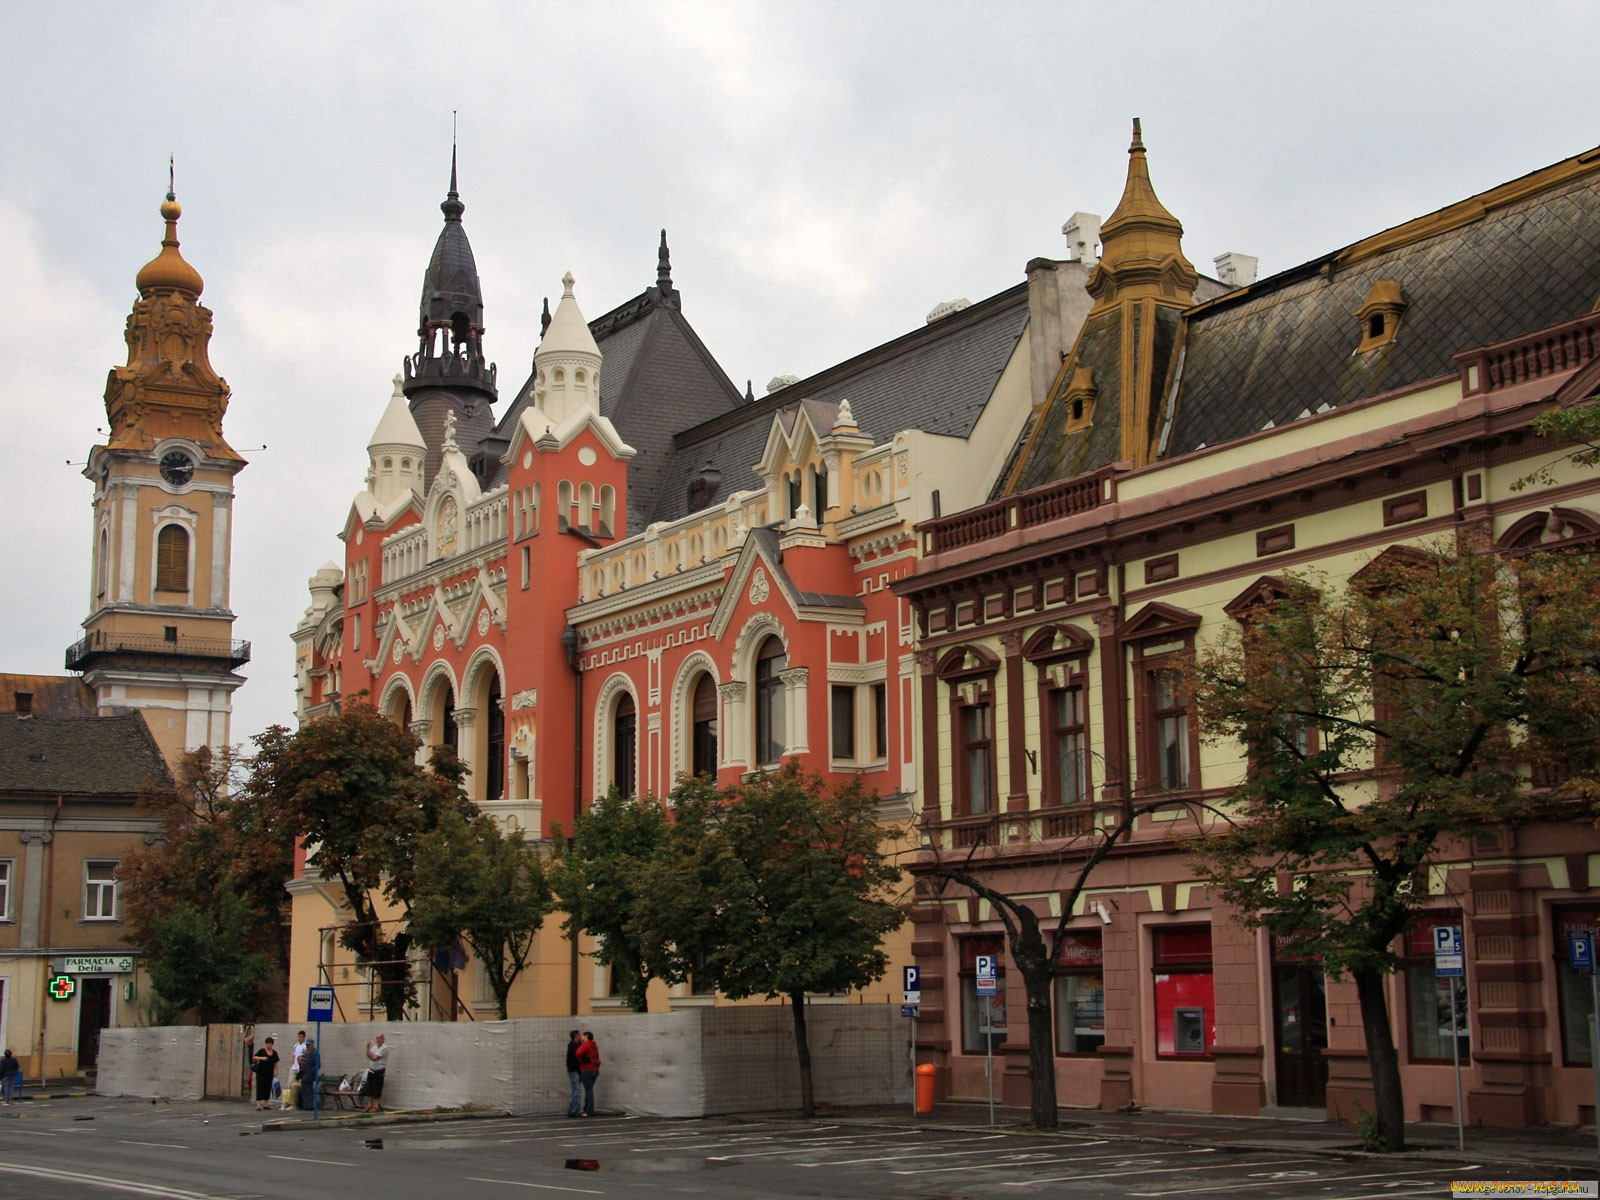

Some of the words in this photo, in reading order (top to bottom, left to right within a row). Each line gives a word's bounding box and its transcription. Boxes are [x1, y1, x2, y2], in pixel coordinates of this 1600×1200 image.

[1437, 928, 1450, 949] P
[1455, 942, 1461, 951] 5
[1575, 941, 1585, 958] P
[979, 957, 988, 974] P
[907, 968, 917, 990] P
